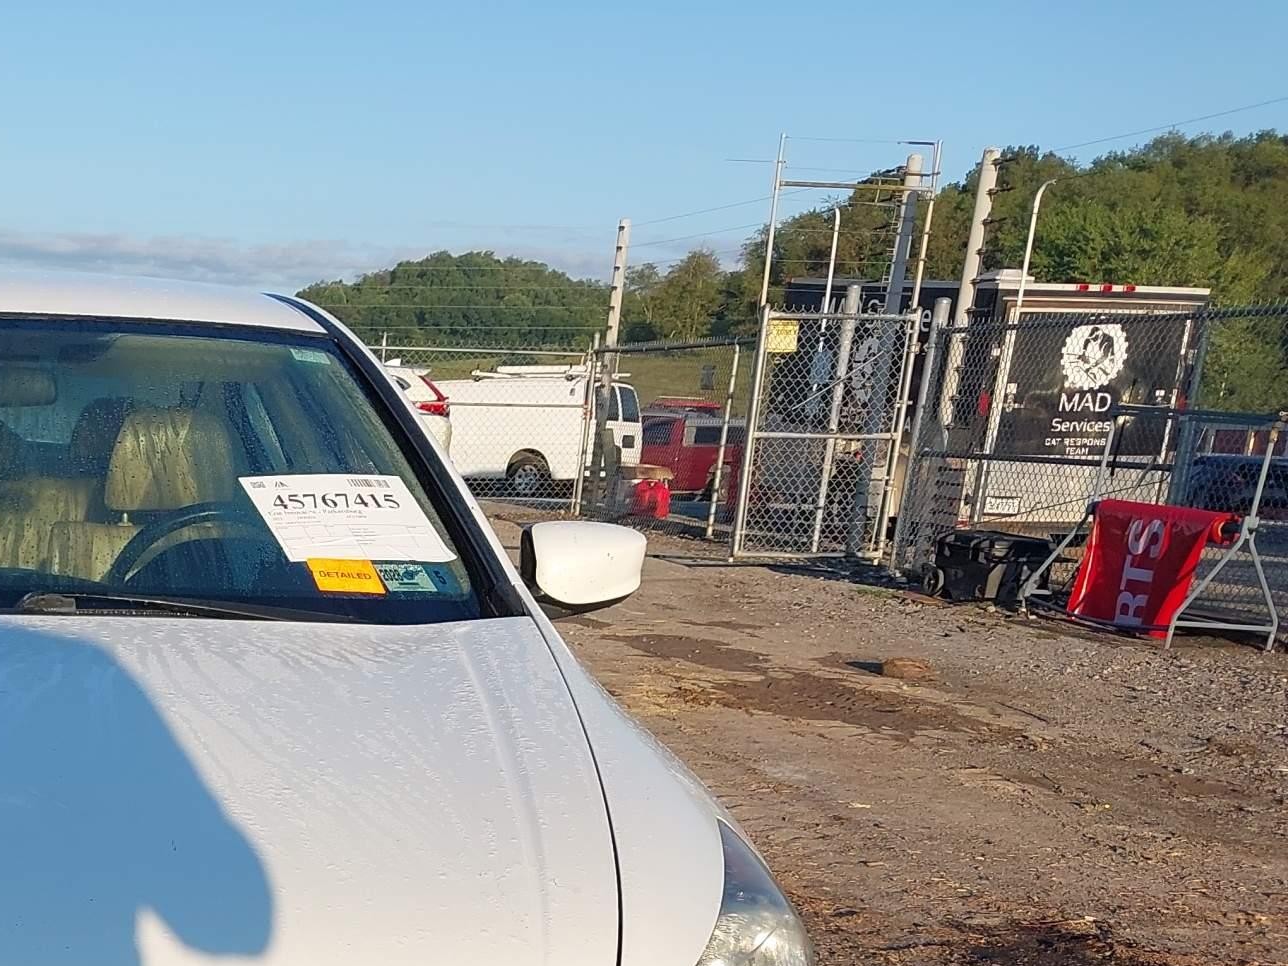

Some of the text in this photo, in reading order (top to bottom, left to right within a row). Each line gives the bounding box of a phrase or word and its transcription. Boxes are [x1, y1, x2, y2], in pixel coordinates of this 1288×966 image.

[1058, 392, 1112, 412] MAD
[1050, 417, 1111, 432] Services
[1044, 437, 1107, 447] CAT RESPONS
[1065, 447, 1089, 455] TEAM
[273, 493, 400, 510] 45767415
[318, 570, 372, 580] DETAILED
